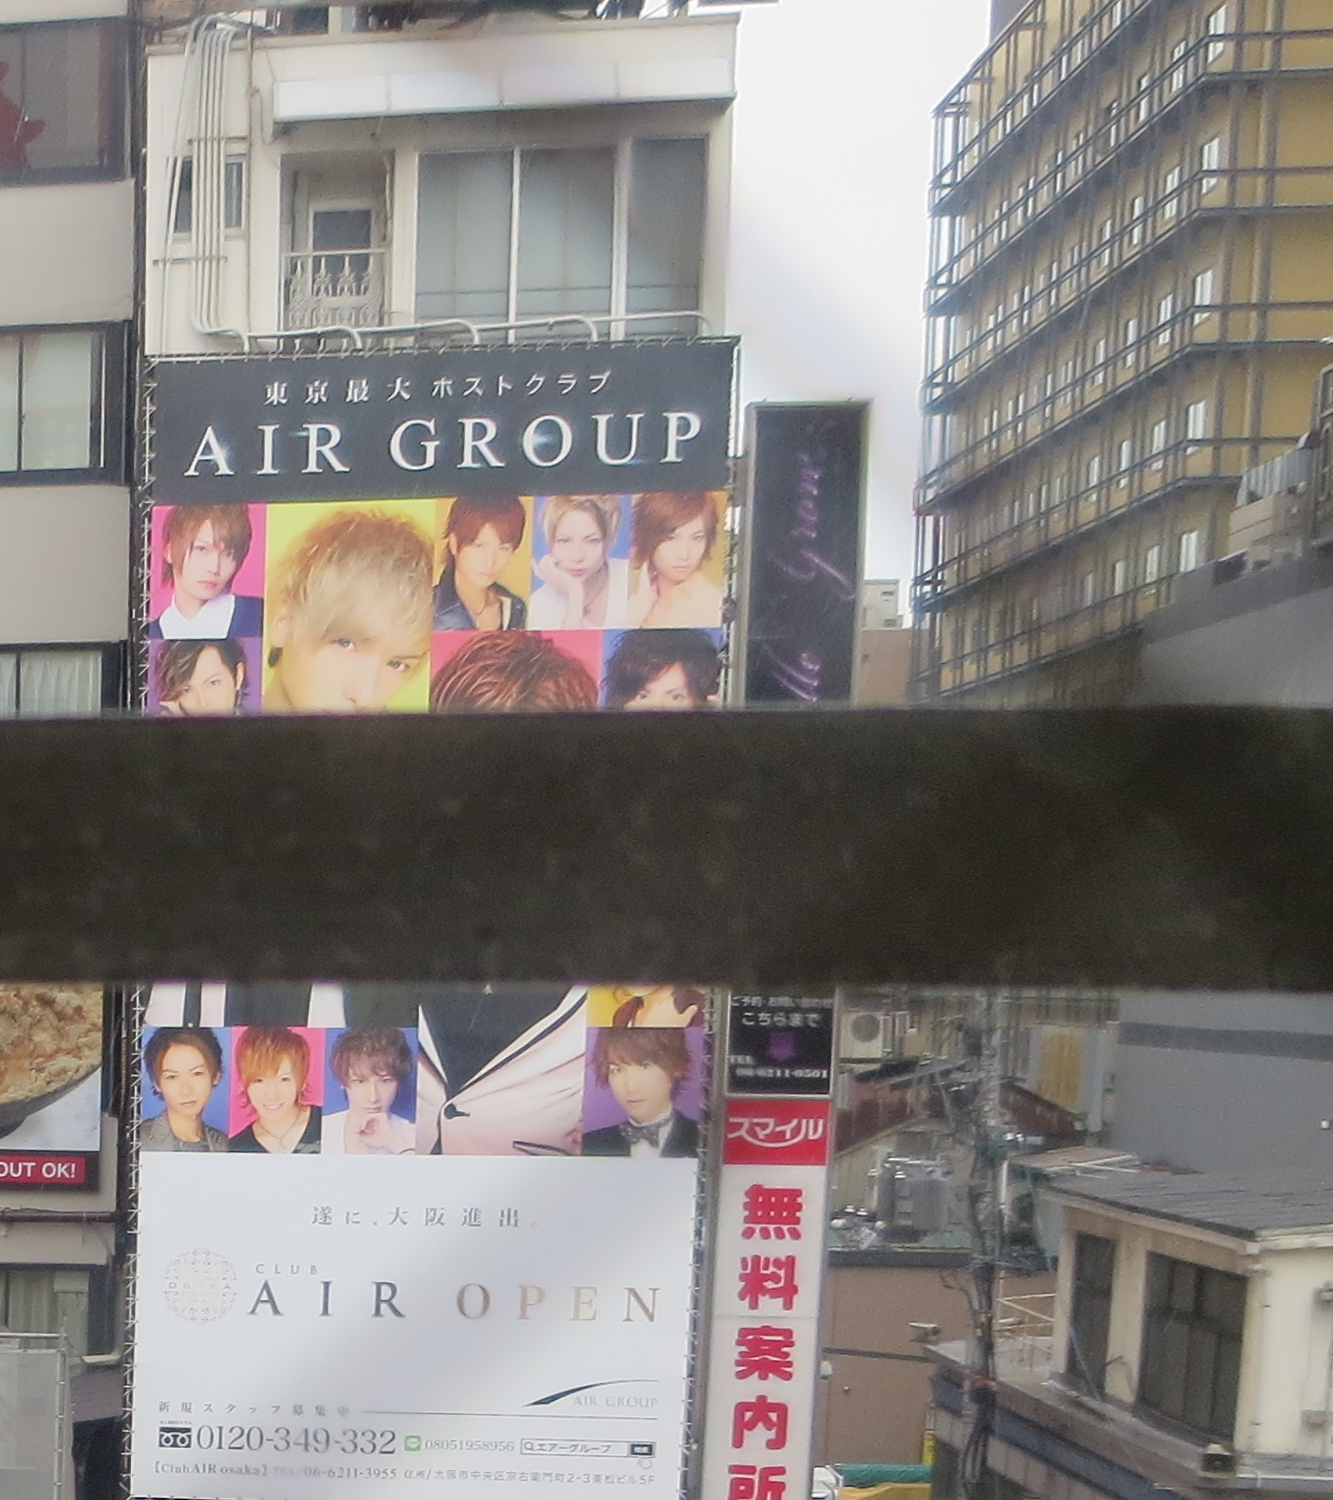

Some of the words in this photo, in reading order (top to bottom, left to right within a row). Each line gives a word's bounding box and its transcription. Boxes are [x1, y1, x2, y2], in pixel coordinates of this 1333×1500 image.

[263, 370, 613, 406] 東京最大ホストクラブ
[184, 421, 351, 478] AIR
[388, 410, 704, 470] GROUP
[726, 1117, 824, 1148] スマイル
[41, 1163, 76, 1180] OK!
[311, 1206, 540, 1230] 遂に、大阪進出。
[255, 1263, 318, 1276] CLUB
[246, 1278, 408, 1321] AIR
[455, 1282, 662, 1323] OPEN
[605, 1396, 659, 1409] GROUP
[195, 1424, 397, 1456] 0120-349-332
